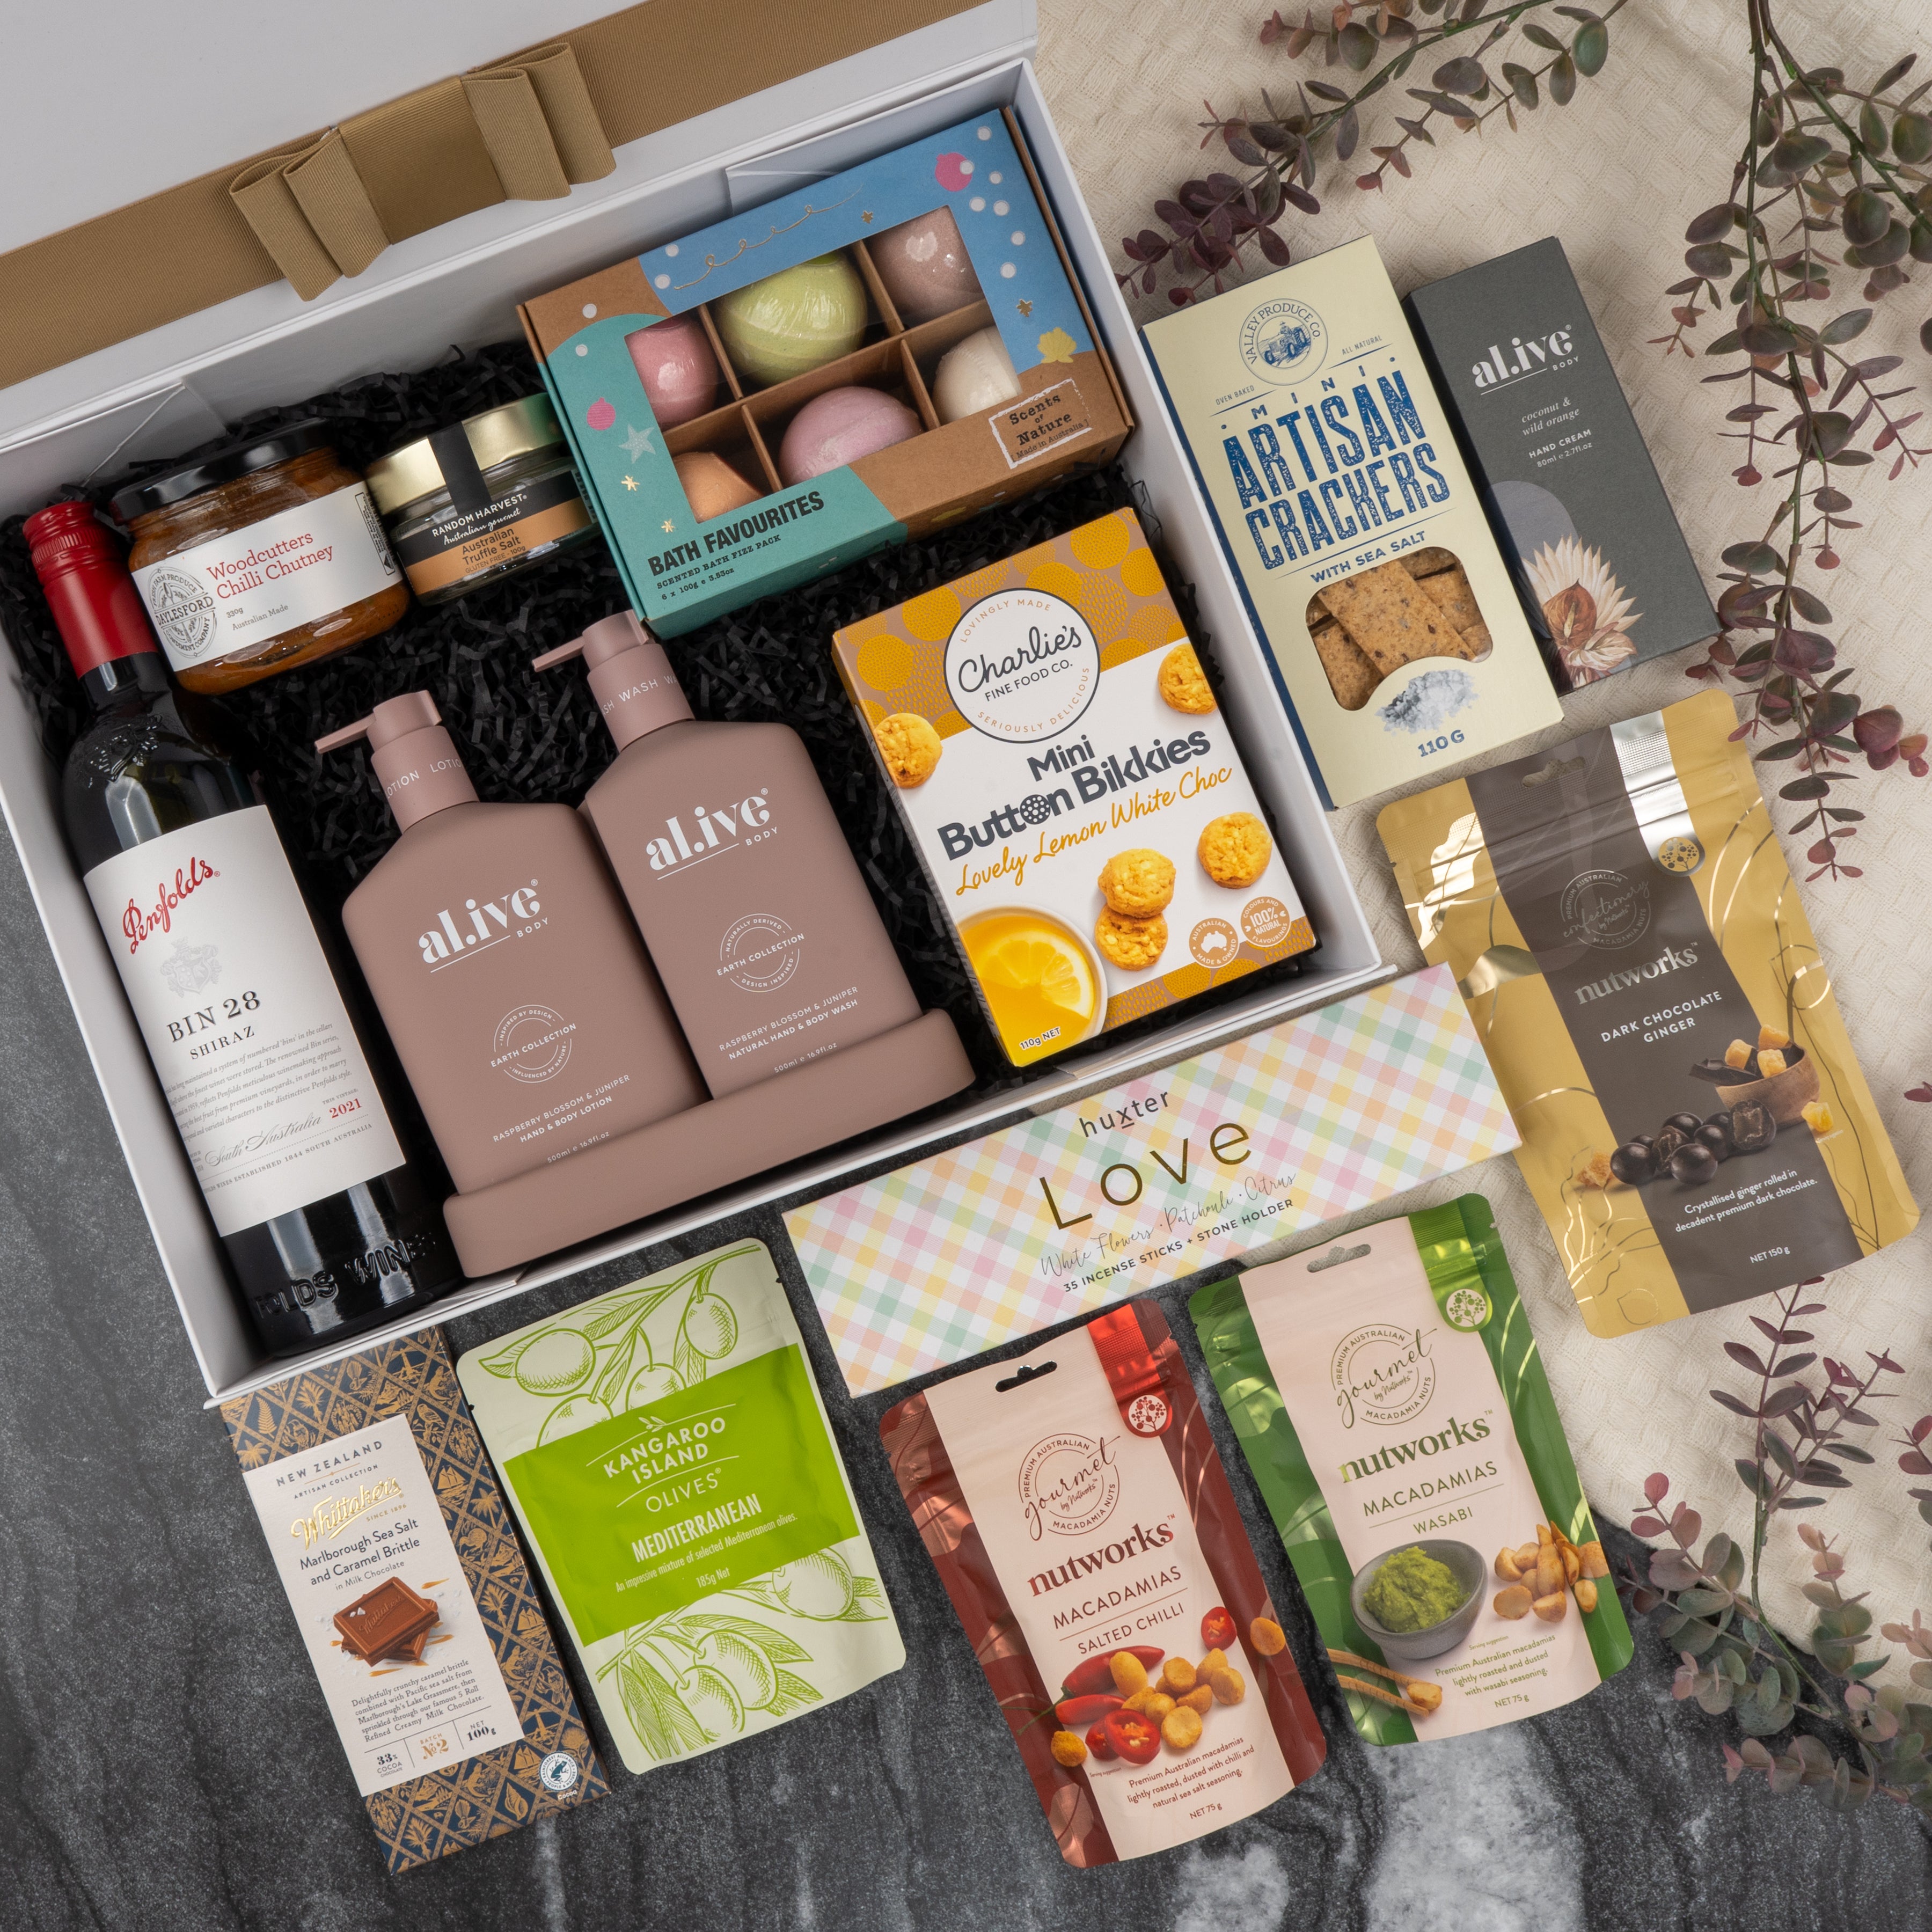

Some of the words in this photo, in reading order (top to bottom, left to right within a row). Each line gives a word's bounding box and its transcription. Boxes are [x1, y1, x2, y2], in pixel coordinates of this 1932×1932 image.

[1244, 316, 1260, 364] VALLEY
[1257, 303, 1313, 323] PRODUCE
[1309, 321, 1321, 340] CO.
[1342, 344, 1353, 355] ALL
[1354, 335, 1383, 350] NATURAL
[1552, 356, 1579, 371] BODY
[1009, 394, 1061, 425] Scents
[1035, 414, 1043, 423] of
[1215, 393, 1233, 406] OVEN
[1234, 385, 1255, 398] BAKED
[1521, 402, 1559, 423] coconut
[1562, 397, 1571, 407] &
[1016, 414, 1072, 445] Nature
[1223, 370, 1426, 509] ARTISAN
[1522, 420, 1543, 436] wild
[1546, 408, 1580, 427] orange
[1528, 443, 1556, 459] HAND
[1558, 429, 1592, 447] CREAM
[432, 514, 474, 537] RANDOM
[444, 524, 487, 545] Australian
[487, 507, 521, 531] gourmet
[1245, 442, 1450, 570] CRACKERS
[207, 533, 313, 580] Woodcutters
[462, 528, 514, 555] Australian
[462, 544, 497, 566] Truffle
[499, 536, 521, 554] Salt
[648, 540, 702, 576] BATH
[704, 491, 824, 553] FAVOURITES
[1311, 561, 1351, 583] WITH
[1355, 548, 1387, 566] SEA
[1390, 530, 1426, 552] SALT
[217, 571, 264, 598] Chilli
[265, 546, 333, 580] Chutney
[656, 567, 700, 589] SCENTED
[702, 555, 730, 571] BATH
[731, 545, 754, 559] FIZZ
[756, 535, 781, 549] PACK
[156, 596, 213, 626] DAYLESFORD
[226, 607, 244, 618] 330g
[232, 613, 268, 631] Australian
[268, 604, 288, 617] Made
[960, 601, 1009, 643] LOVINGLY
[1018, 599, 1051, 611] MADE
[958, 625, 1081, 693] Charlie's
[985, 683, 1013, 702] FINE
[1014, 668, 1049, 689] FOOD
[1051, 660, 1073, 672] CO.
[618, 679, 658, 702] WASH
[978, 712, 1043, 733] SERIOUSLY
[1050, 668, 1089, 725] DELICIOUS
[1027, 734, 1096, 782] Mini
[937, 787, 1075, 861] Button
[1071, 730, 1211, 804] Bikkies
[745, 826, 778, 846] BODY
[956, 846, 1027, 896] Lovely
[1034, 821, 1107, 863] Lemon
[1111, 788, 1176, 828] White
[1179, 766, 1232, 799] Choc
[517, 917, 548, 938] BODY
[717, 958, 747, 976] EARTH
[749, 933, 804, 962] COLLECTION
[166, 1006, 216, 1043] BIN
[223, 990, 260, 1019] 28
[719, 1025, 768, 1052] RASPBERRY
[770, 1006, 812, 1029] BLOSSOM
[823, 986, 858, 1007] JUNIPER
[729, 1038, 769, 1060] NATURAL
[770, 1027, 795, 1042] HAND
[806, 1011, 829, 1027] BODY
[831, 999, 858, 1015] WASH
[1020, 1037, 1041, 1049] 110g
[1042, 1027, 1060, 1040] NET
[1600, 1021, 1641, 1042] DARK
[1642, 990, 1723, 1027] CHOCOLATE
[1643, 1017, 1696, 1043] GINGER
[189, 1026, 255, 1060] SHIRAZ
[491, 1050, 519, 1067] EARTH
[522, 1023, 576, 1052] COLLECTION
[328, 1098, 363, 1119] 2021
[493, 1115, 541, 1142] RASPBERRY
[543, 1096, 584, 1119] BLOSSOM
[595, 1074, 630, 1096] JUNIPER
[519, 1127, 545, 1143] HAND
[555, 1111, 578, 1127] BODY
[580, 1096, 612, 1115] LOTION
[1079, 1091, 1168, 1138] huxter
[204, 1139, 245, 1167] South
[245, 1111, 322, 1152] Australia
[1675, 1214, 1716, 1233] decadent
[1716, 1201, 1755, 1221] premium
[1755, 1192, 1776, 1205] dark
[1776, 1179, 1818, 1196] chocolate.
[1684, 1190, 1736, 1214] Crystallised
[1736, 1183, 1762, 1200] ginger
[1764, 1174, 1788, 1187] rolled
[1788, 1169, 1798, 1179] in
[1063, 1281, 1078, 1292] 35
[1081, 1258, 1137, 1285] INCENSE
[1139, 1241, 1183, 1263] STICKS
[1196, 1220, 1239, 1241] STONE
[1241, 1198, 1294, 1225] HOLDER
[1337, 1328, 1438, 1429] gourmet
[276, 1468, 307, 1487] NEW
[313, 1440, 383, 1473] ZEALAND
[603, 1417, 726, 1478] KANGAROO
[632, 1443, 708, 1484] ISLAND
[294, 1483, 327, 1499] ARTISAN
[329, 1464, 379, 1486] COLLECTION
[1024, 1436, 1121, 1541] gourmet
[1363, 1461, 1497, 1517] MACADAMIAS
[631, 1493, 762, 1563] MEDITERRANEAN
[1413, 1506, 1473, 1534] WASABI
[299, 1536, 372, 1570] Marlborough
[372, 1528, 394, 1542] Sea
[394, 1518, 419, 1534] Salt
[310, 1569, 331, 1585] and
[333, 1550, 381, 1576] Caramel
[383, 1537, 420, 1557] Brittle
[334, 1583, 343, 1591] in
[345, 1575, 363, 1587] Milk
[364, 1560, 405, 1579] Chocolate
[696, 1574, 717, 1589] 185g
[715, 1567, 730, 1579] Net
[1053, 1566, 1181, 1629] MACADAMIAS
[1078, 1625, 1132, 1654] SALTED
[1136, 1602, 1184, 1630] CHILLI
[1435, 1663, 1470, 1677] Premium
[1472, 1651, 1511, 1667] Australian
[1512, 1634, 1556, 1655] macadamias
[1129, 1772, 1163, 1788] Premium
[1165, 1757, 1201, 1776] Australian
[1202, 1737, 1244, 1760] macadamias
